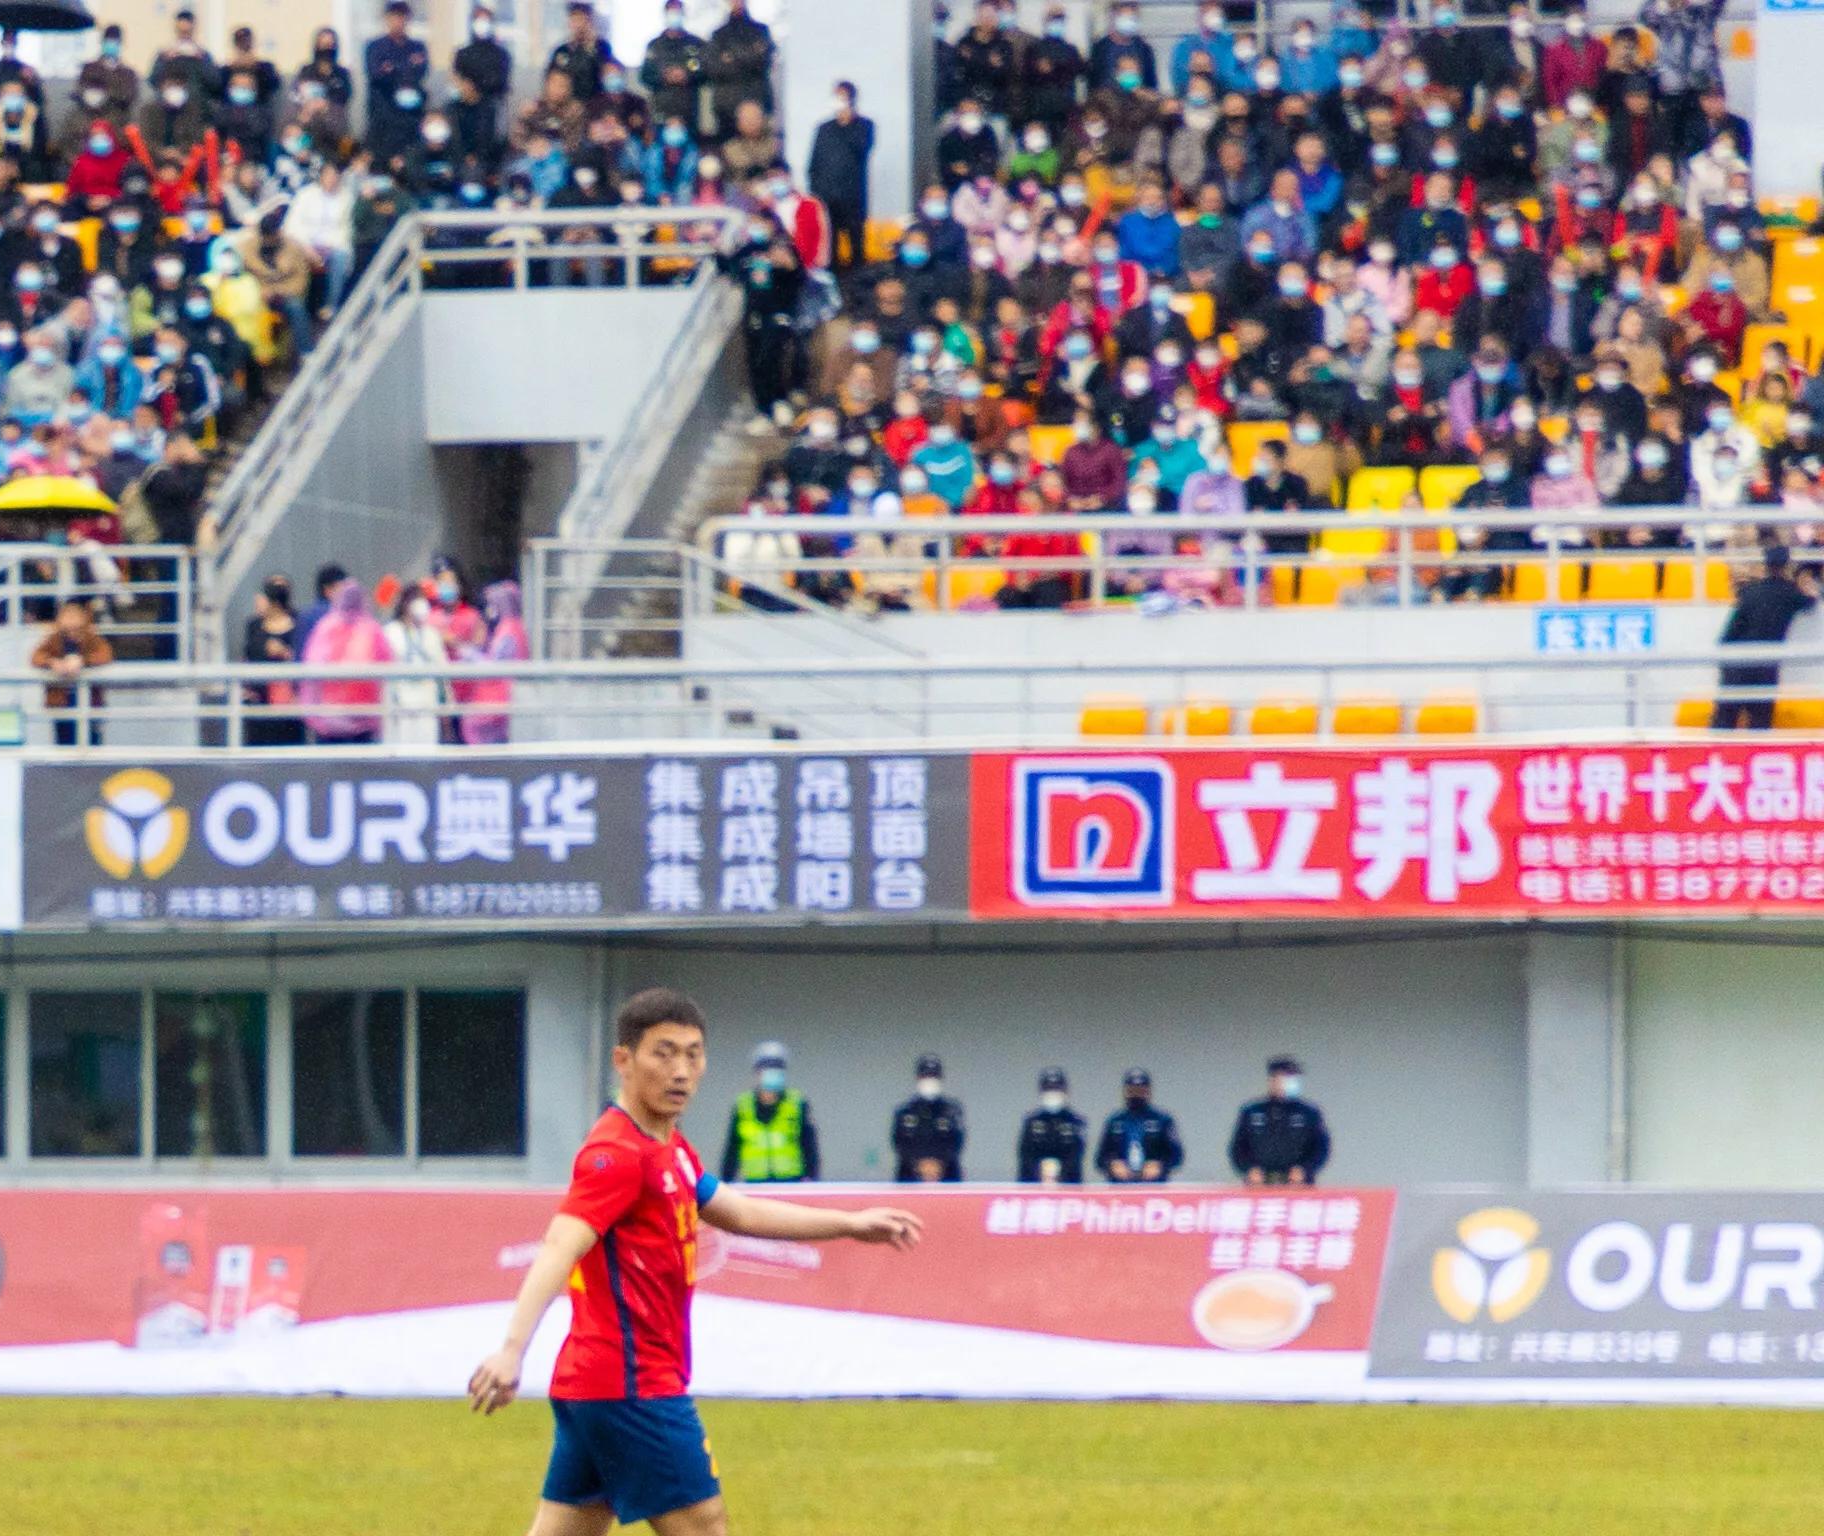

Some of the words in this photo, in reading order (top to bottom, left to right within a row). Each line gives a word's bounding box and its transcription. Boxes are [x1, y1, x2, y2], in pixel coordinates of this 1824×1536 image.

[646, 759, 927, 813] 集成吊顶
[646, 811, 927, 863] 集成墙面
[1192, 760, 1502, 903] 立邦
[646, 861, 927, 912] 集成阳台
